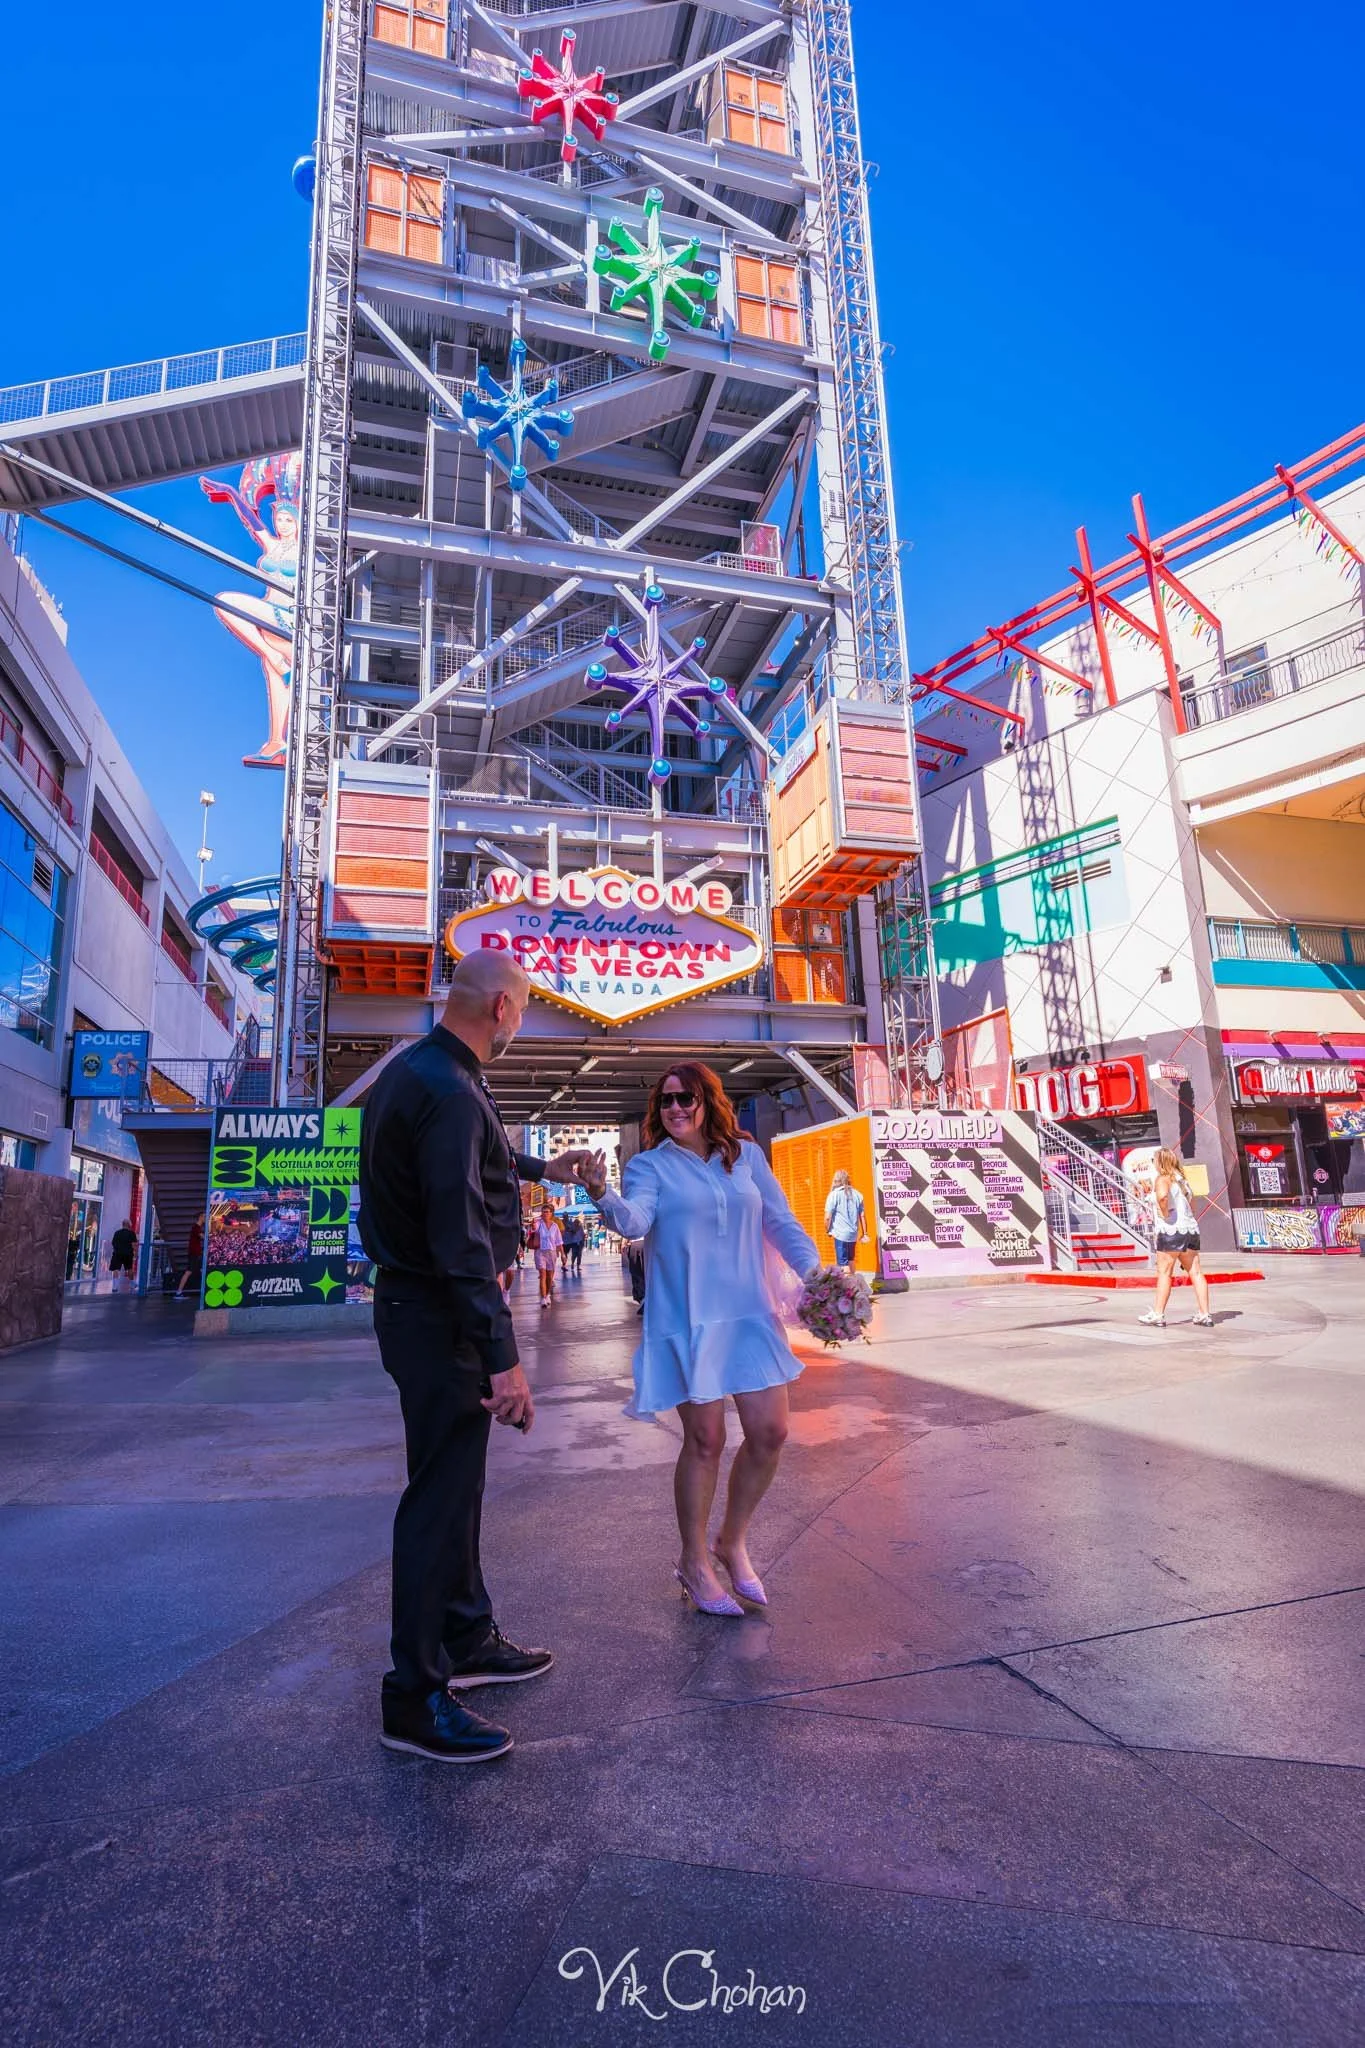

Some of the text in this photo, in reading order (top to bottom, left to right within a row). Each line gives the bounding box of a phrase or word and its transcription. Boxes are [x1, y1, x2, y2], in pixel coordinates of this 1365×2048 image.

[490, 874, 725, 909] WELCOME
[516, 910, 683, 936] TO Fabulous
[480, 932, 731, 962] DOWNTOWN
[514, 954, 705, 979] LAS VEGAS
[559, 980, 663, 996] NEVADA
[81, 1033, 142, 1046] POLICE
[1312, 1066, 1358, 1093] DOG
[1015, 1064, 1101, 1121] DOG
[218, 1113, 320, 1139] ALWAYS
[877, 1118, 998, 1141] 2026 LINEUP
[271, 1160, 360, 1169] SLOTZILLA BOX OFFIC
[930, 1161, 956, 1169] GEORGE
[932, 1180, 958, 1188] SLEEPING
[884, 1191, 919, 1199] CROSSFADE
[888, 1235, 908, 1243] FINGER
[948, 1233, 962, 1241] YEAR
[311, 1246, 345, 1256] ZIPLINE
[991, 1239, 1030, 1250] SUMMER
[987, 1249, 1037, 1259] CONCERT SERIES
[901, 1264, 918, 1272] MORE
[248, 1277, 304, 1295] SLOTZILLA
